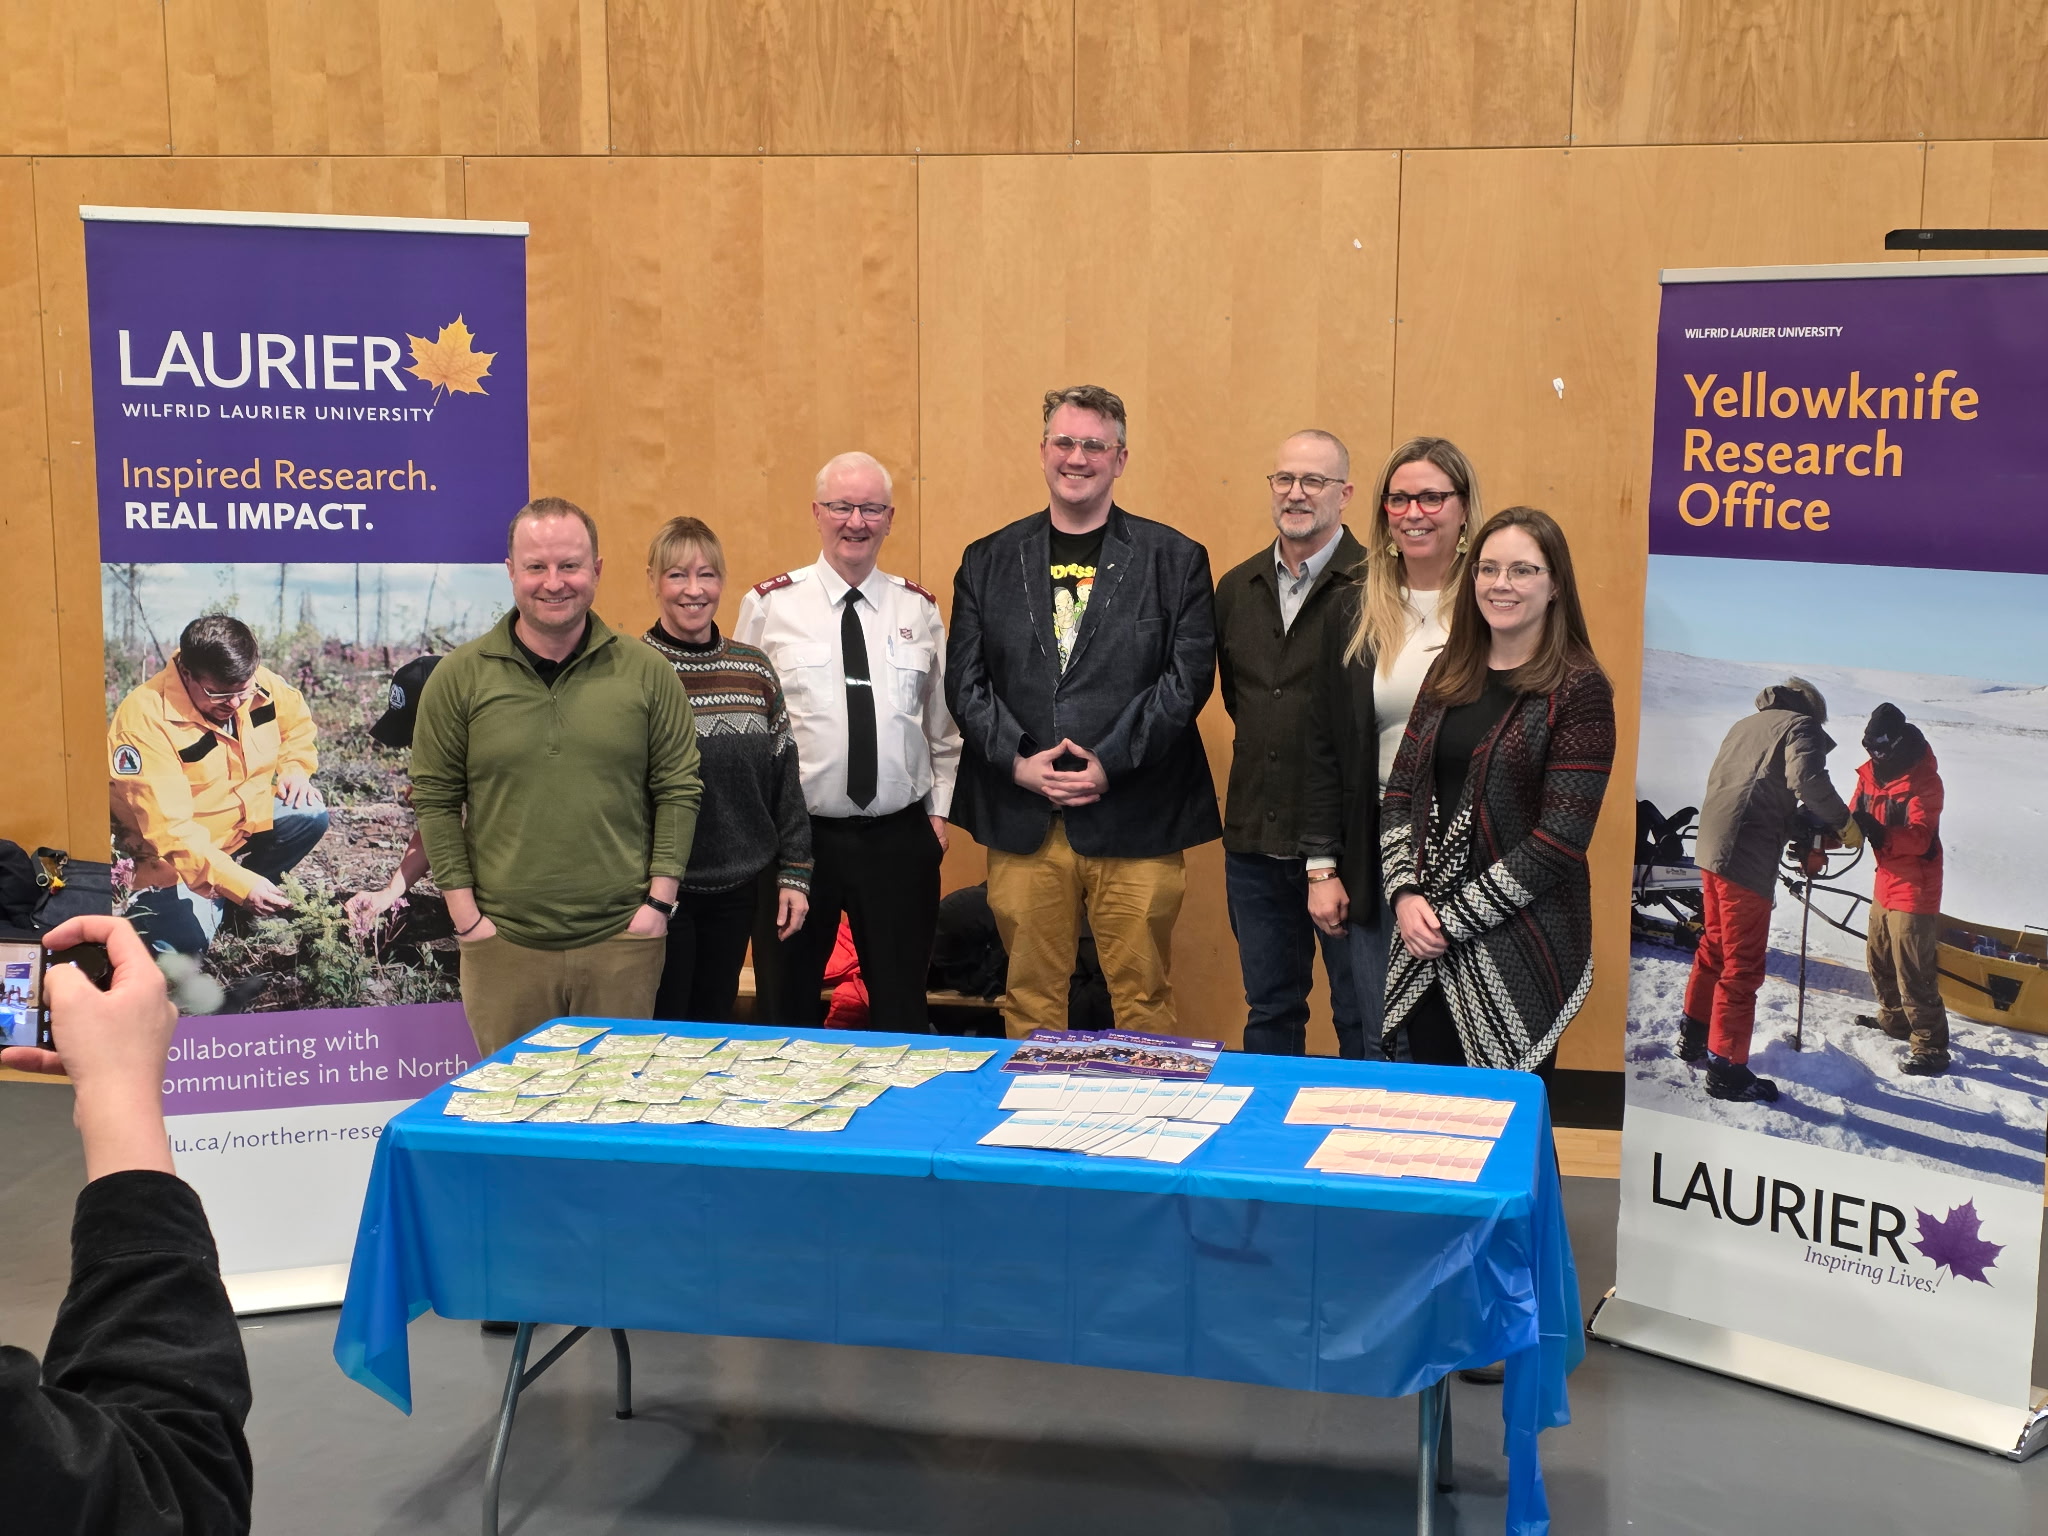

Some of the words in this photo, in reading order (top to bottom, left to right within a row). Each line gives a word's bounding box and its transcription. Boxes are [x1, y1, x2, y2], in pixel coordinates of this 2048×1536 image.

[1684, 327, 1729, 339] WILFRID
[1730, 327, 1776, 338] LAURIER
[1777, 326, 1844, 338] UNIVERSITY
[118, 329, 408, 392] LAURIER
[121, 403, 211, 418] WILFRID
[219, 404, 307, 420] LAURIER
[314, 406, 435, 422] UNIVERSITY
[1683, 369, 1979, 421] Yellowknife
[1683, 428, 1903, 477] Research
[122, 457, 261, 498] Inspired
[275, 459, 437, 491] Research.
[124, 501, 218, 530] REAL
[227, 502, 374, 531] IMPACT.
[1678, 480, 1831, 532] Office
[167, 1033, 317, 1062] ollaborating
[324, 1027, 379, 1052] with
[161, 1066, 310, 1095] ommunities
[318, 1063, 339, 1084] in
[348, 1059, 389, 1083] the
[398, 1053, 468, 1079] North
[168, 1126, 383, 1154] lu.ca/northern-rese
[1652, 1151, 1910, 1265] LAURIER
[1804, 1245, 1884, 1286] Inspiring
[1887, 1265, 1936, 1294] Lives.
